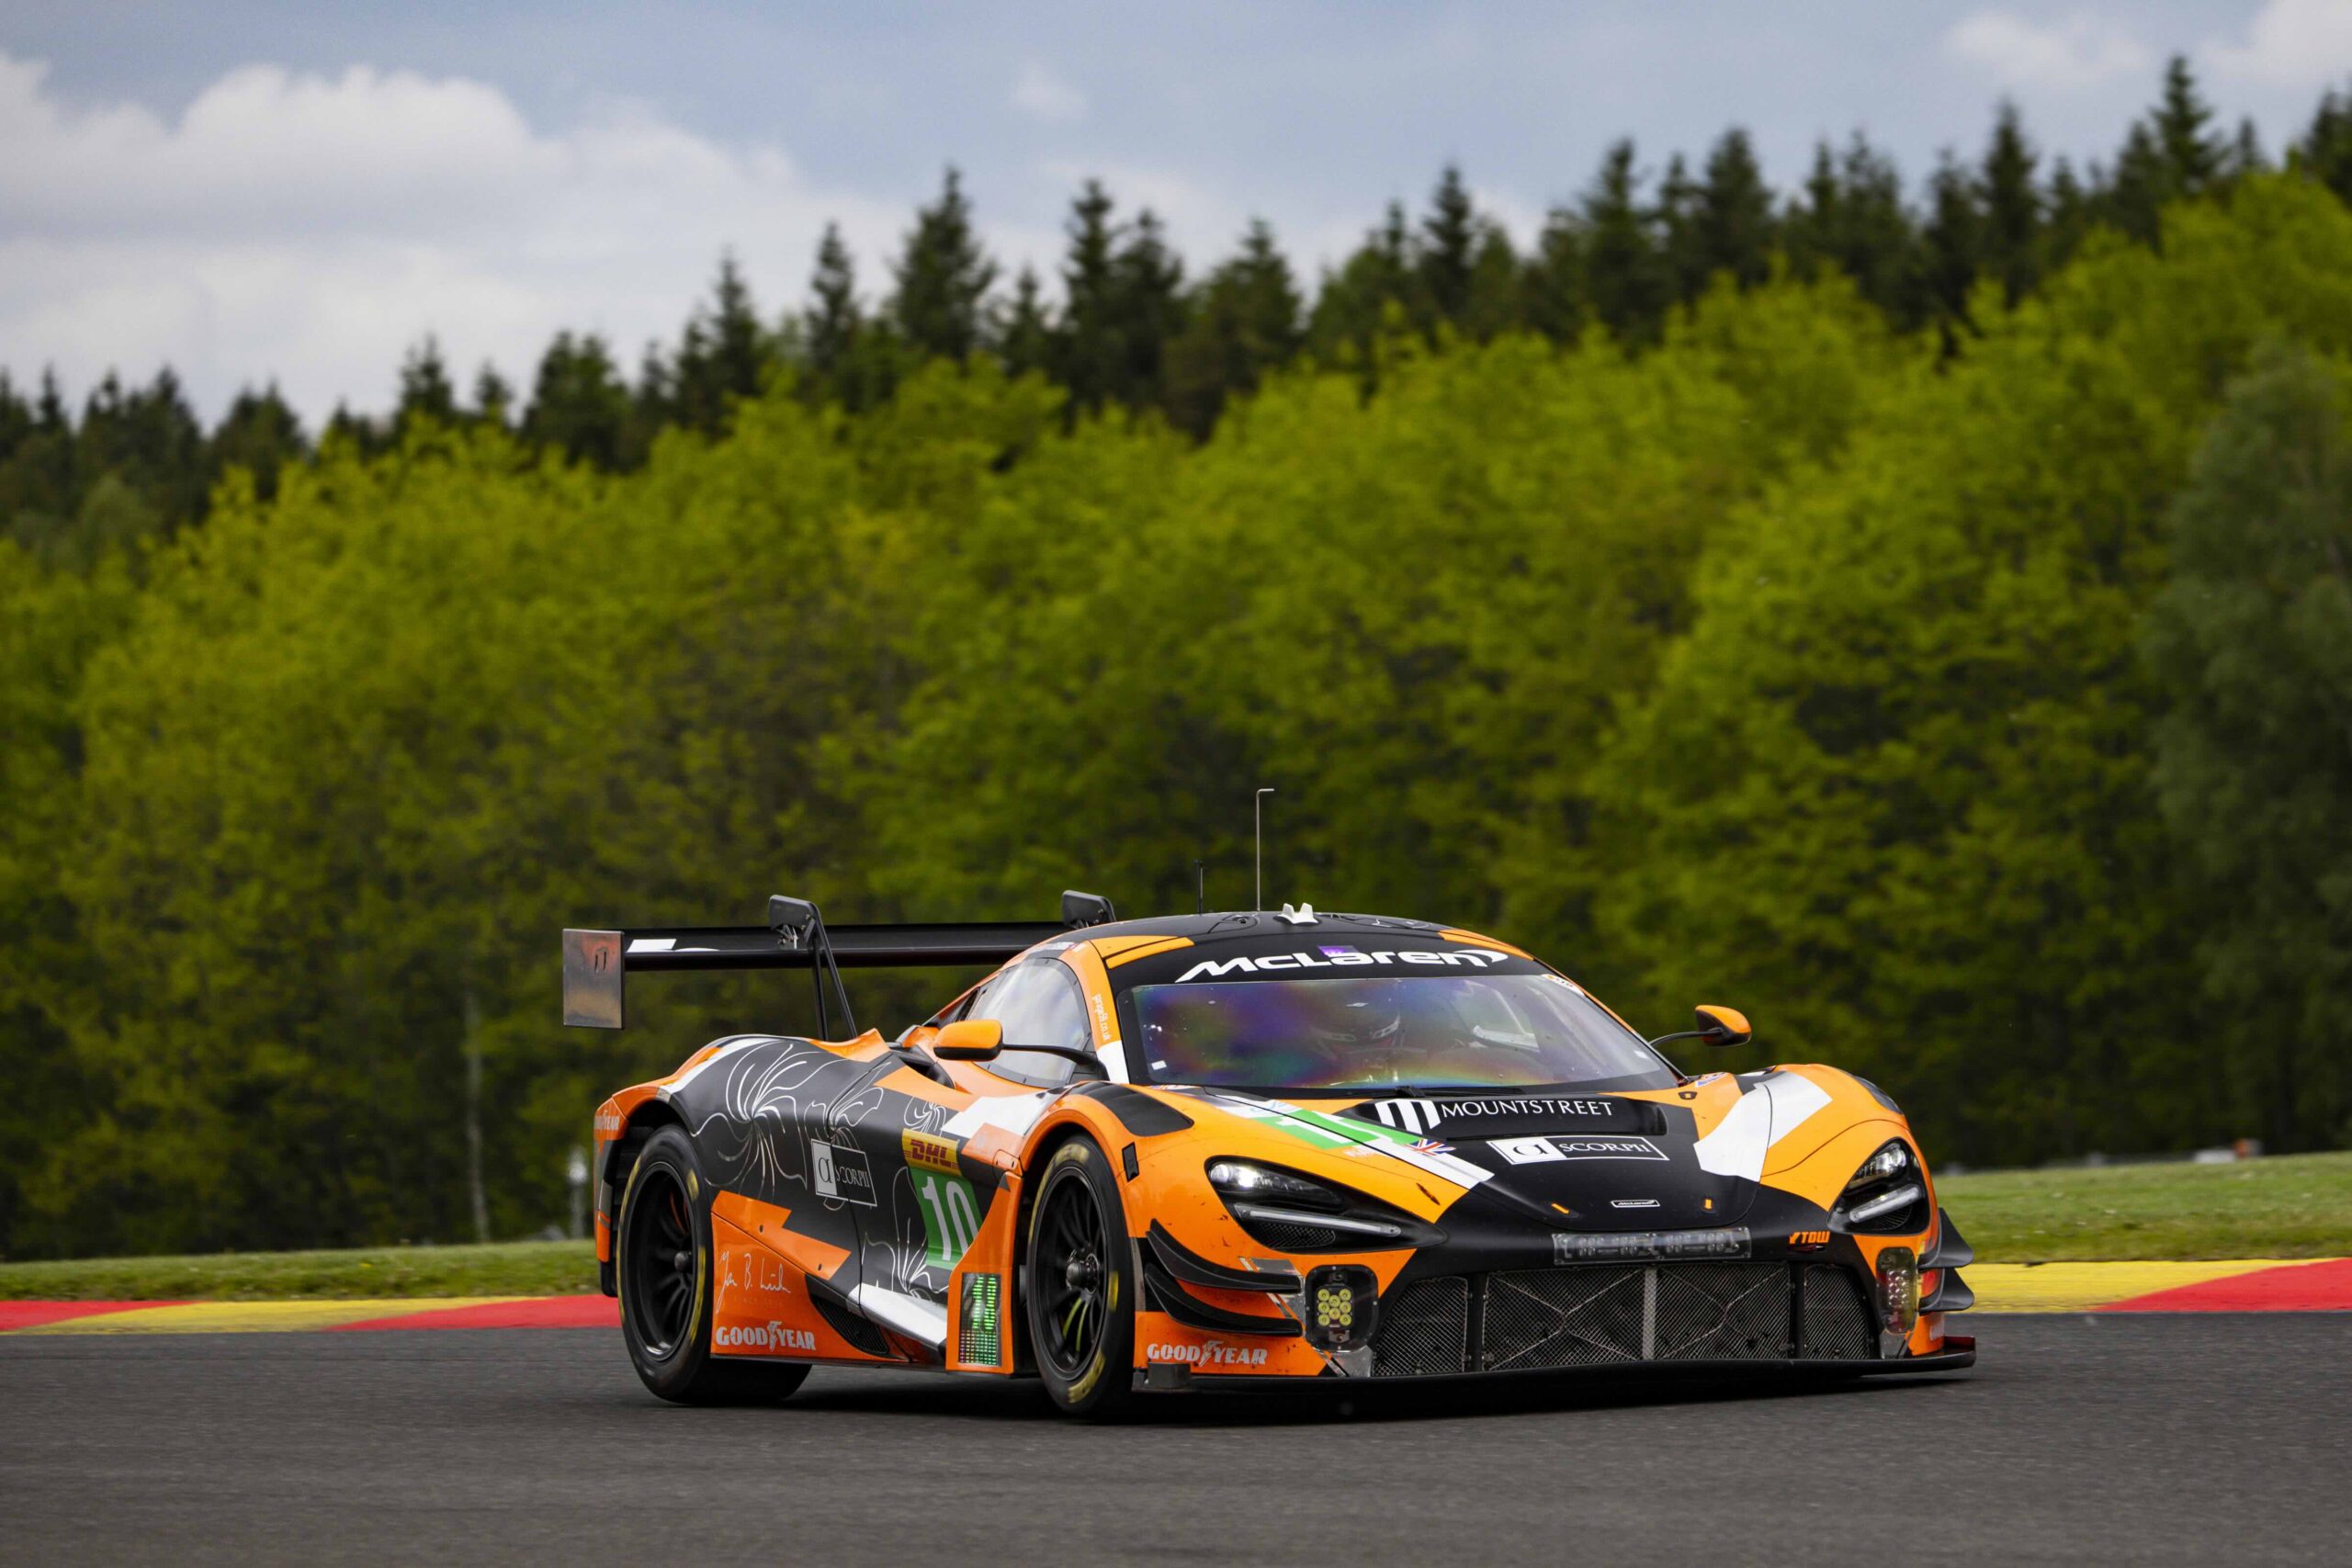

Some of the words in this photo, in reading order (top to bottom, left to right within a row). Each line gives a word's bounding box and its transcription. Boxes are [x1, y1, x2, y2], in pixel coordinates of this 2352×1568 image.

[1174, 949, 1509, 983] McLaren
[1442, 1100, 1611, 1117] MOUNTSTREET
[910, 1138, 952, 1168] DHL
[1559, 1143, 1652, 1153] SCORPII
[922, 1176, 980, 1261] 10
[1800, 1231, 1831, 1244] TOW
[716, 1321, 816, 1352] GOODYEAR
[1147, 1340, 1268, 1367] GOODYEAR
